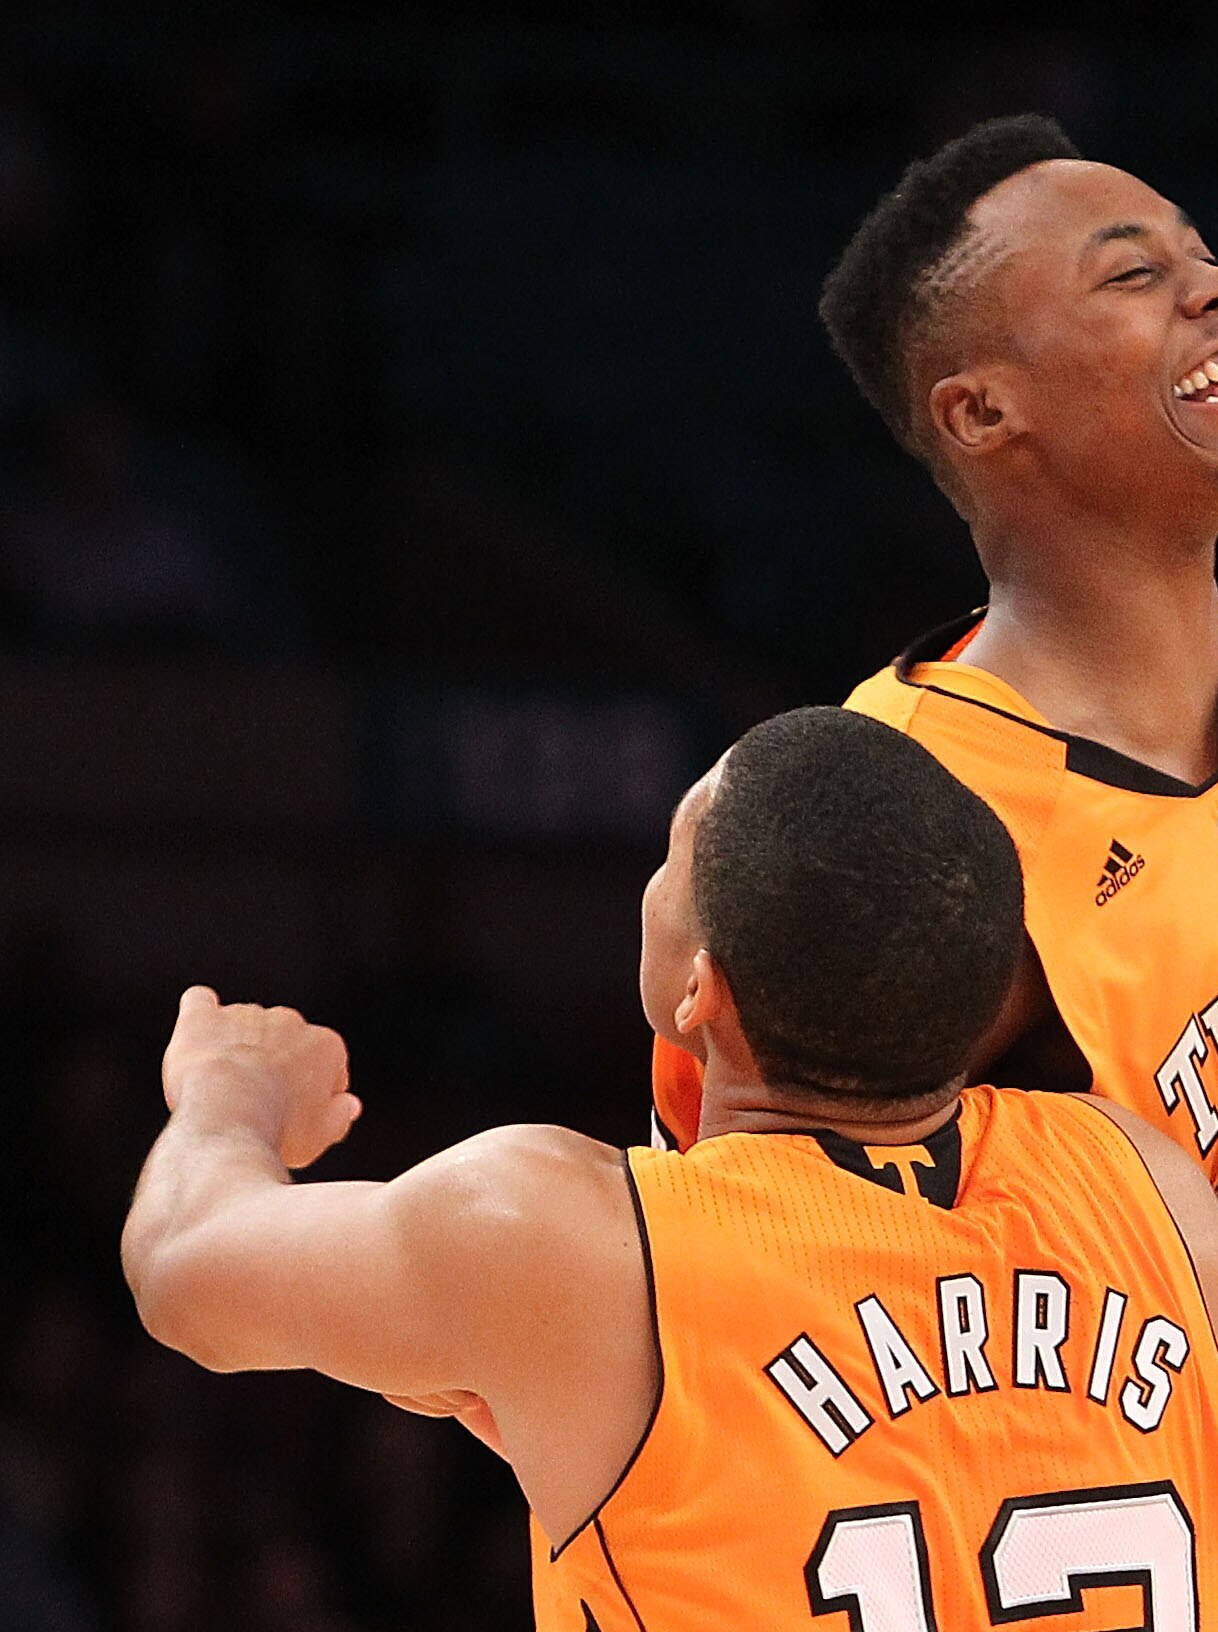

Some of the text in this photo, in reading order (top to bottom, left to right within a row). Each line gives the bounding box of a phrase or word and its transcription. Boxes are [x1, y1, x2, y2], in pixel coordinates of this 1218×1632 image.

[1095, 854, 1146, 907] adidas
[863, 1145, 936, 1203] T
[764, 1268, 1190, 1459] HARRIS
